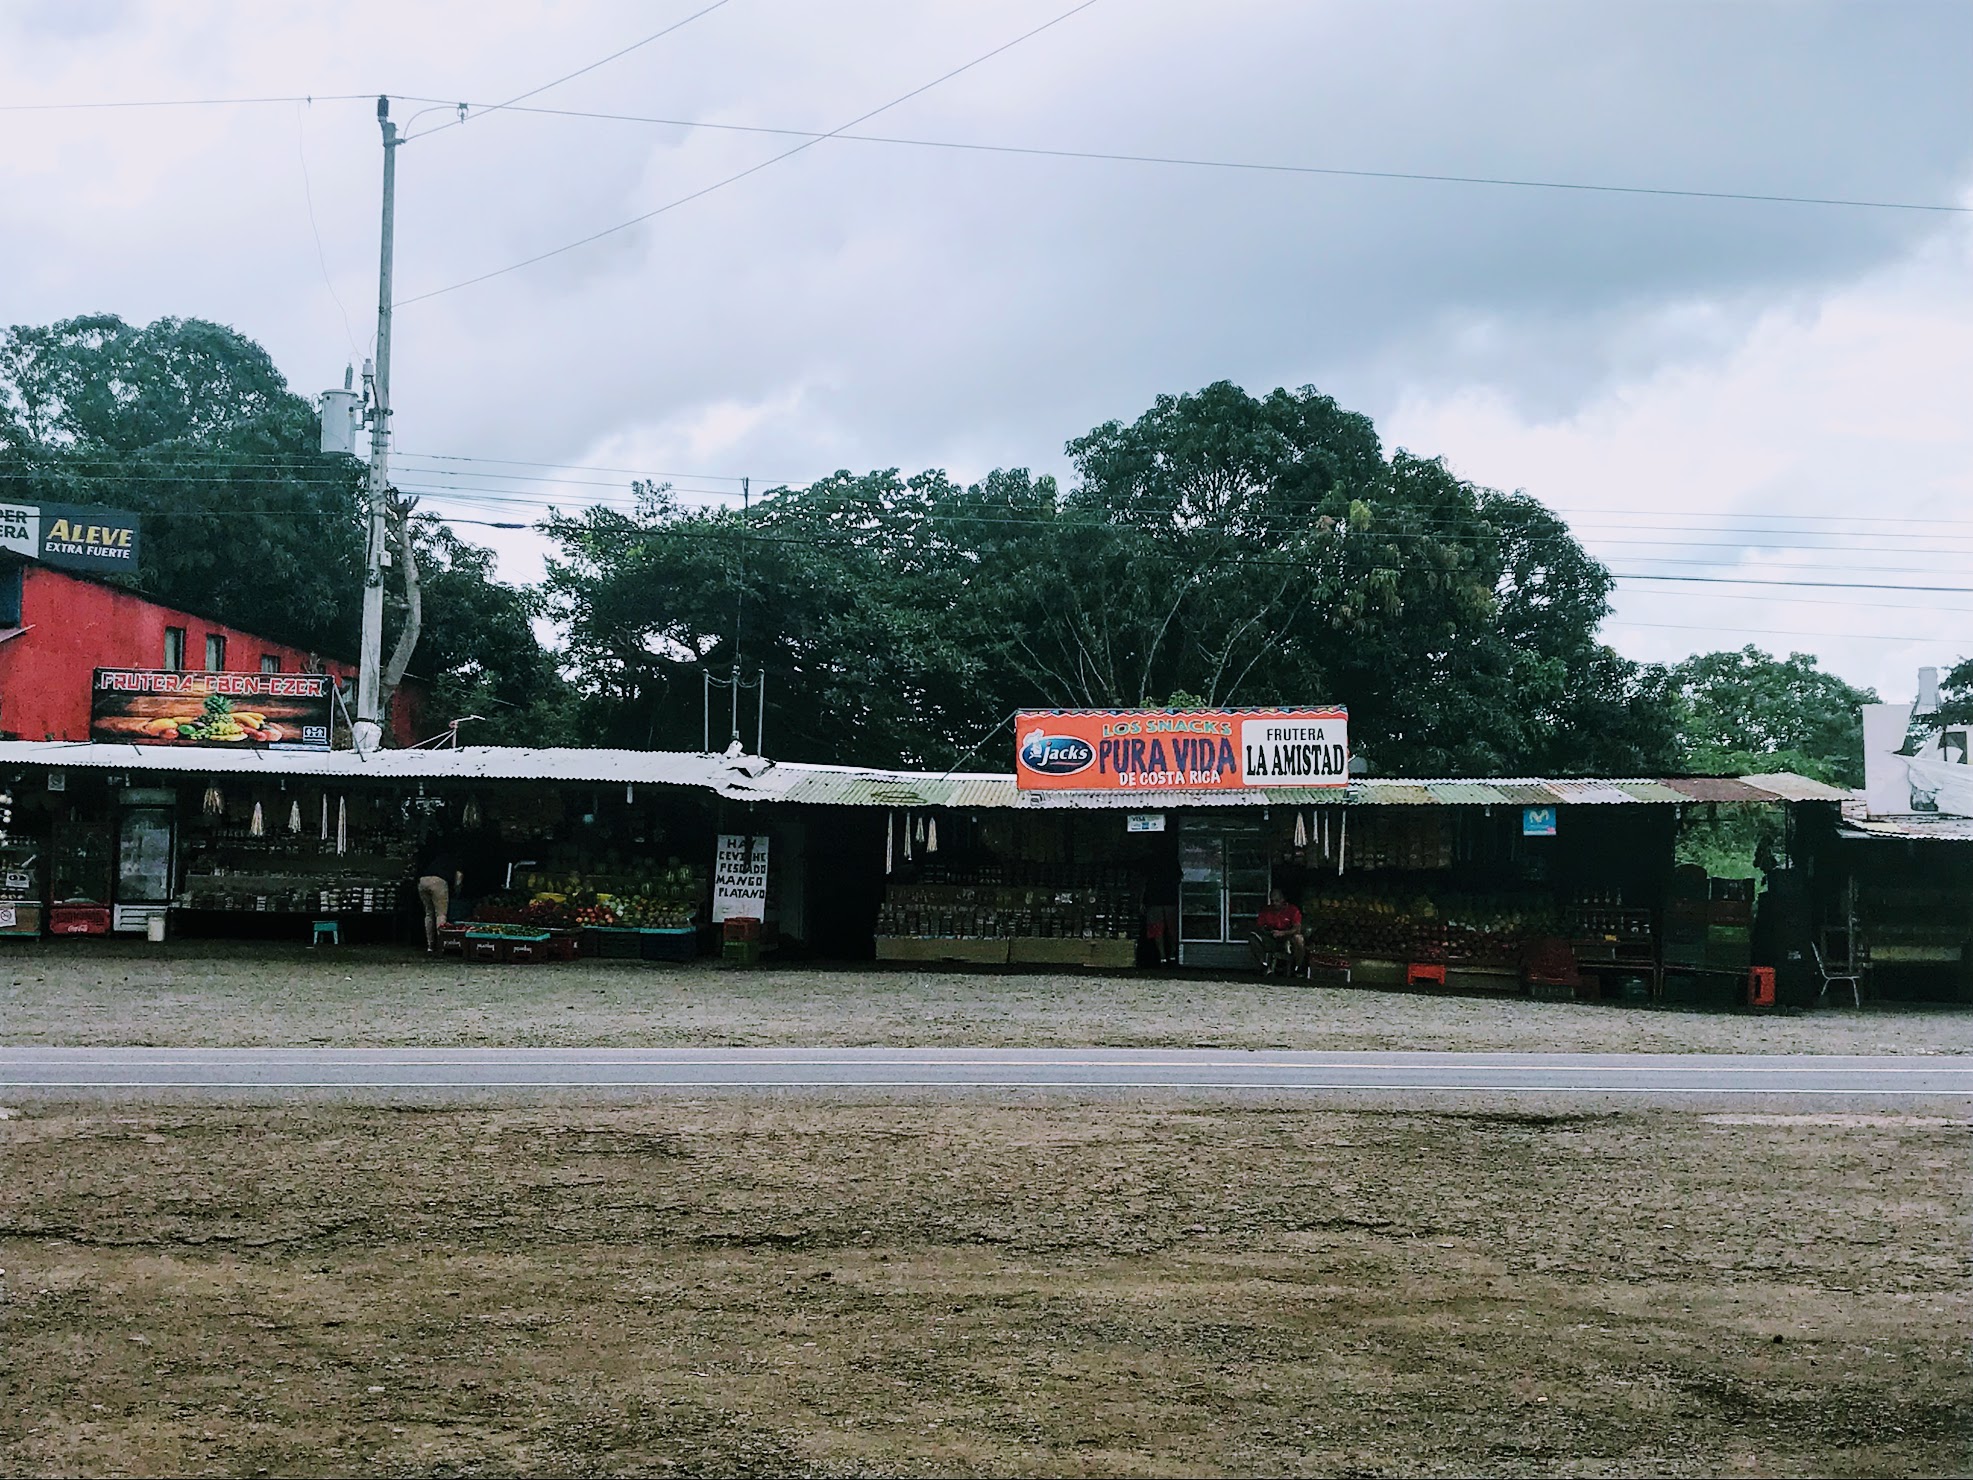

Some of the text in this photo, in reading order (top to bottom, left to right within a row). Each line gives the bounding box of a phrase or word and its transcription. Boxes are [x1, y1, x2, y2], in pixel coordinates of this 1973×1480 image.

[46, 519, 134, 548] ALEVE
[45, 542, 131, 559] EXTRA FUERTE
[101, 672, 324, 697] FRUTERA EBEN-EZER
[1103, 719, 1232, 738] LOS SNACKS
[1267, 728, 1325, 741] FRUTERA
[1100, 737, 1236, 774] PURA VIDA
[1246, 744, 1345, 776] LA AMISTAD
[1119, 770, 1221, 786] DE COSTA RICA
[715, 875, 762, 886] MANGO
[718, 887, 765, 898] PLATANO
